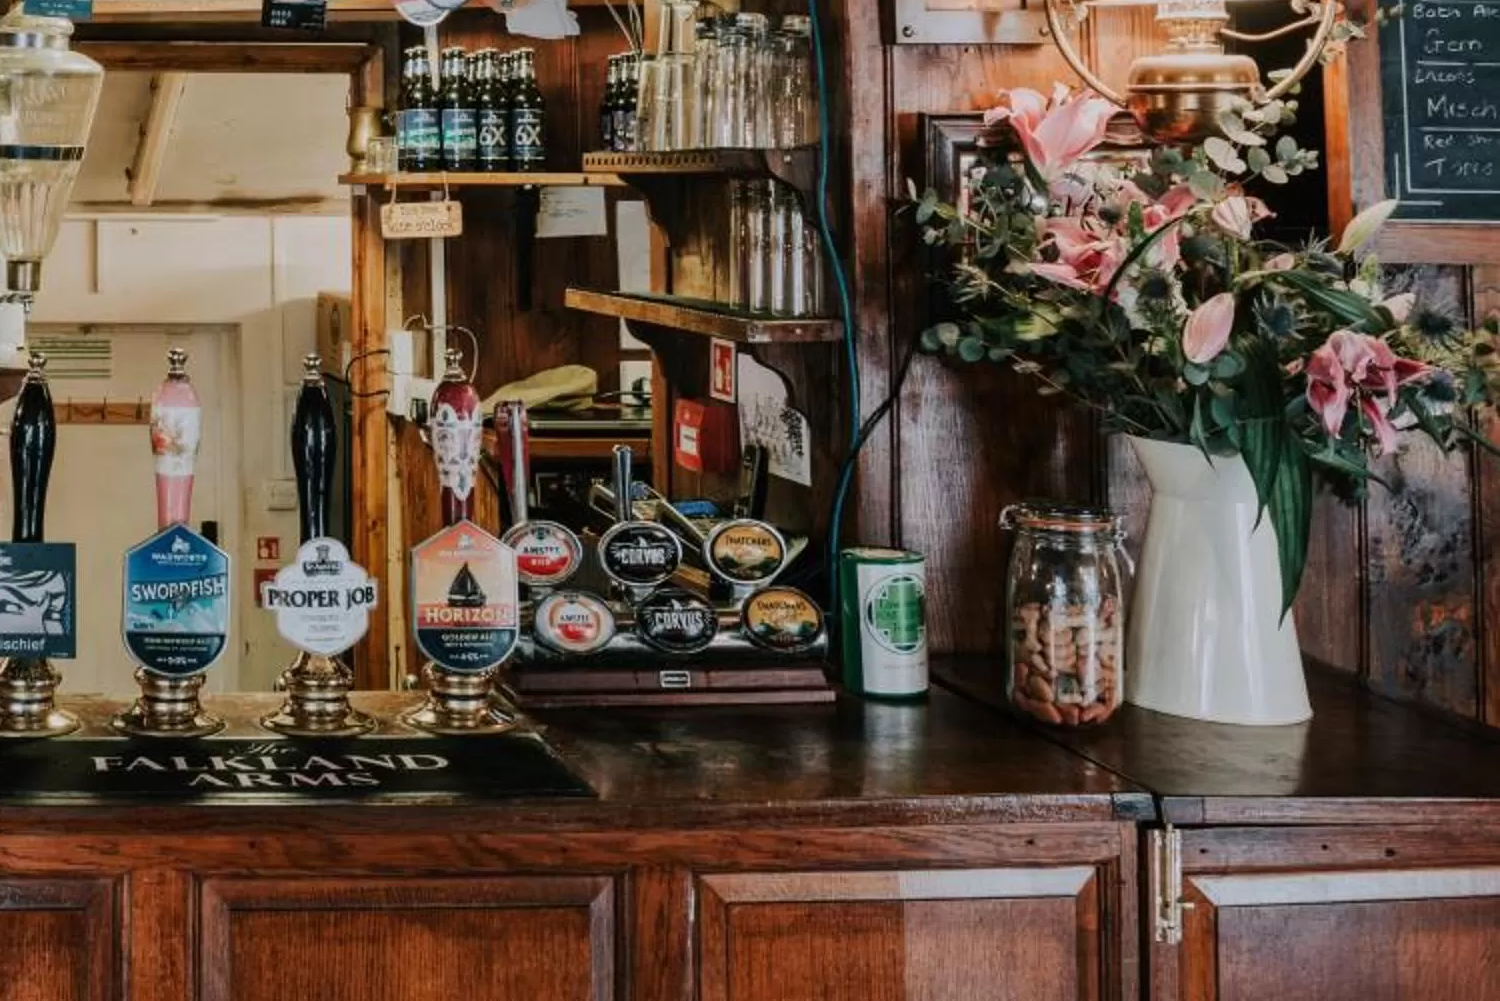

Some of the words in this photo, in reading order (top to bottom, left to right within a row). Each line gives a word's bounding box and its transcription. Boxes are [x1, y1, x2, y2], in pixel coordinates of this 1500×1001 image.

[1412, 3, 1461, 19] Bath
[1423, 27, 1483, 54] Gem
[1426, 95, 1498, 119] Misch
[479, 124, 506, 146] 6X
[514, 124, 541, 146] 6X
[724, 534, 773, 547] THATCHERS
[620, 547, 666, 565] CORVUS
[131, 574, 227, 602] SWORDFISH
[267, 589, 340, 609] PROPER
[345, 586, 376, 611] JOB
[756, 600, 808, 612] THATCHERS
[425, 606, 511, 624] HORIZON
[654, 611, 704, 630] CORVUS
[90, 755, 450, 771] FALKLAND
[187, 772, 381, 787] ARMS
